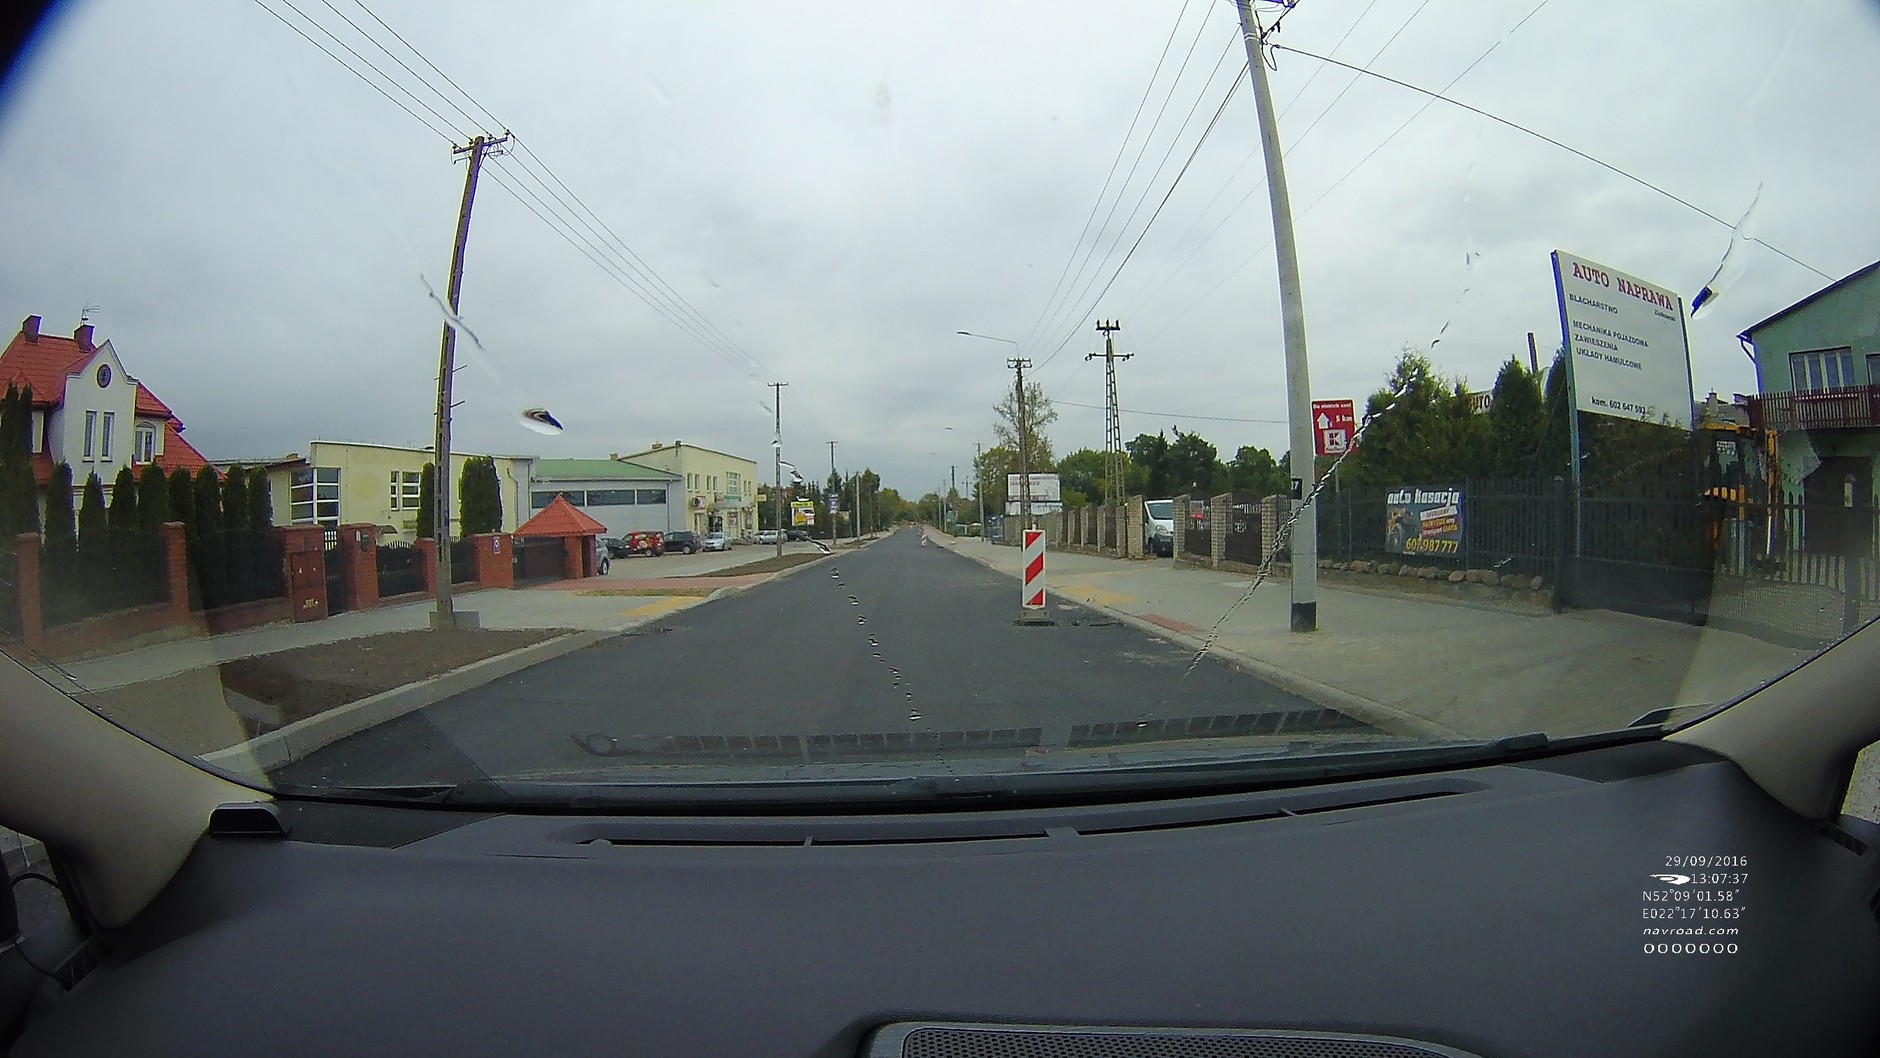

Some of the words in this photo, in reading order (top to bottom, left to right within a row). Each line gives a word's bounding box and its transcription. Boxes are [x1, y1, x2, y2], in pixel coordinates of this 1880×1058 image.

[1573, 262, 1610, 288] AUTO
[1617, 277, 1674, 311] NAPRAWA
[1569, 293, 1618, 314] BLACHARSTWO
[1573, 320, 1612, 337] MECHANIKA
[1613, 331, 1649, 348] POJAZDOWA
[1575, 333, 1619, 351] ZAWIESZENIA
[1576, 347, 1603, 360] UKŁADY
[1604, 354, 1642, 371] HAMULCOWE
[1609, 400, 1621, 410] 602
[1622, 402, 1634, 412] 647
[1387, 489, 1412, 504] auto
[1423, 539, 1441, 552] 987
[1441, 540, 1459, 554] 777
